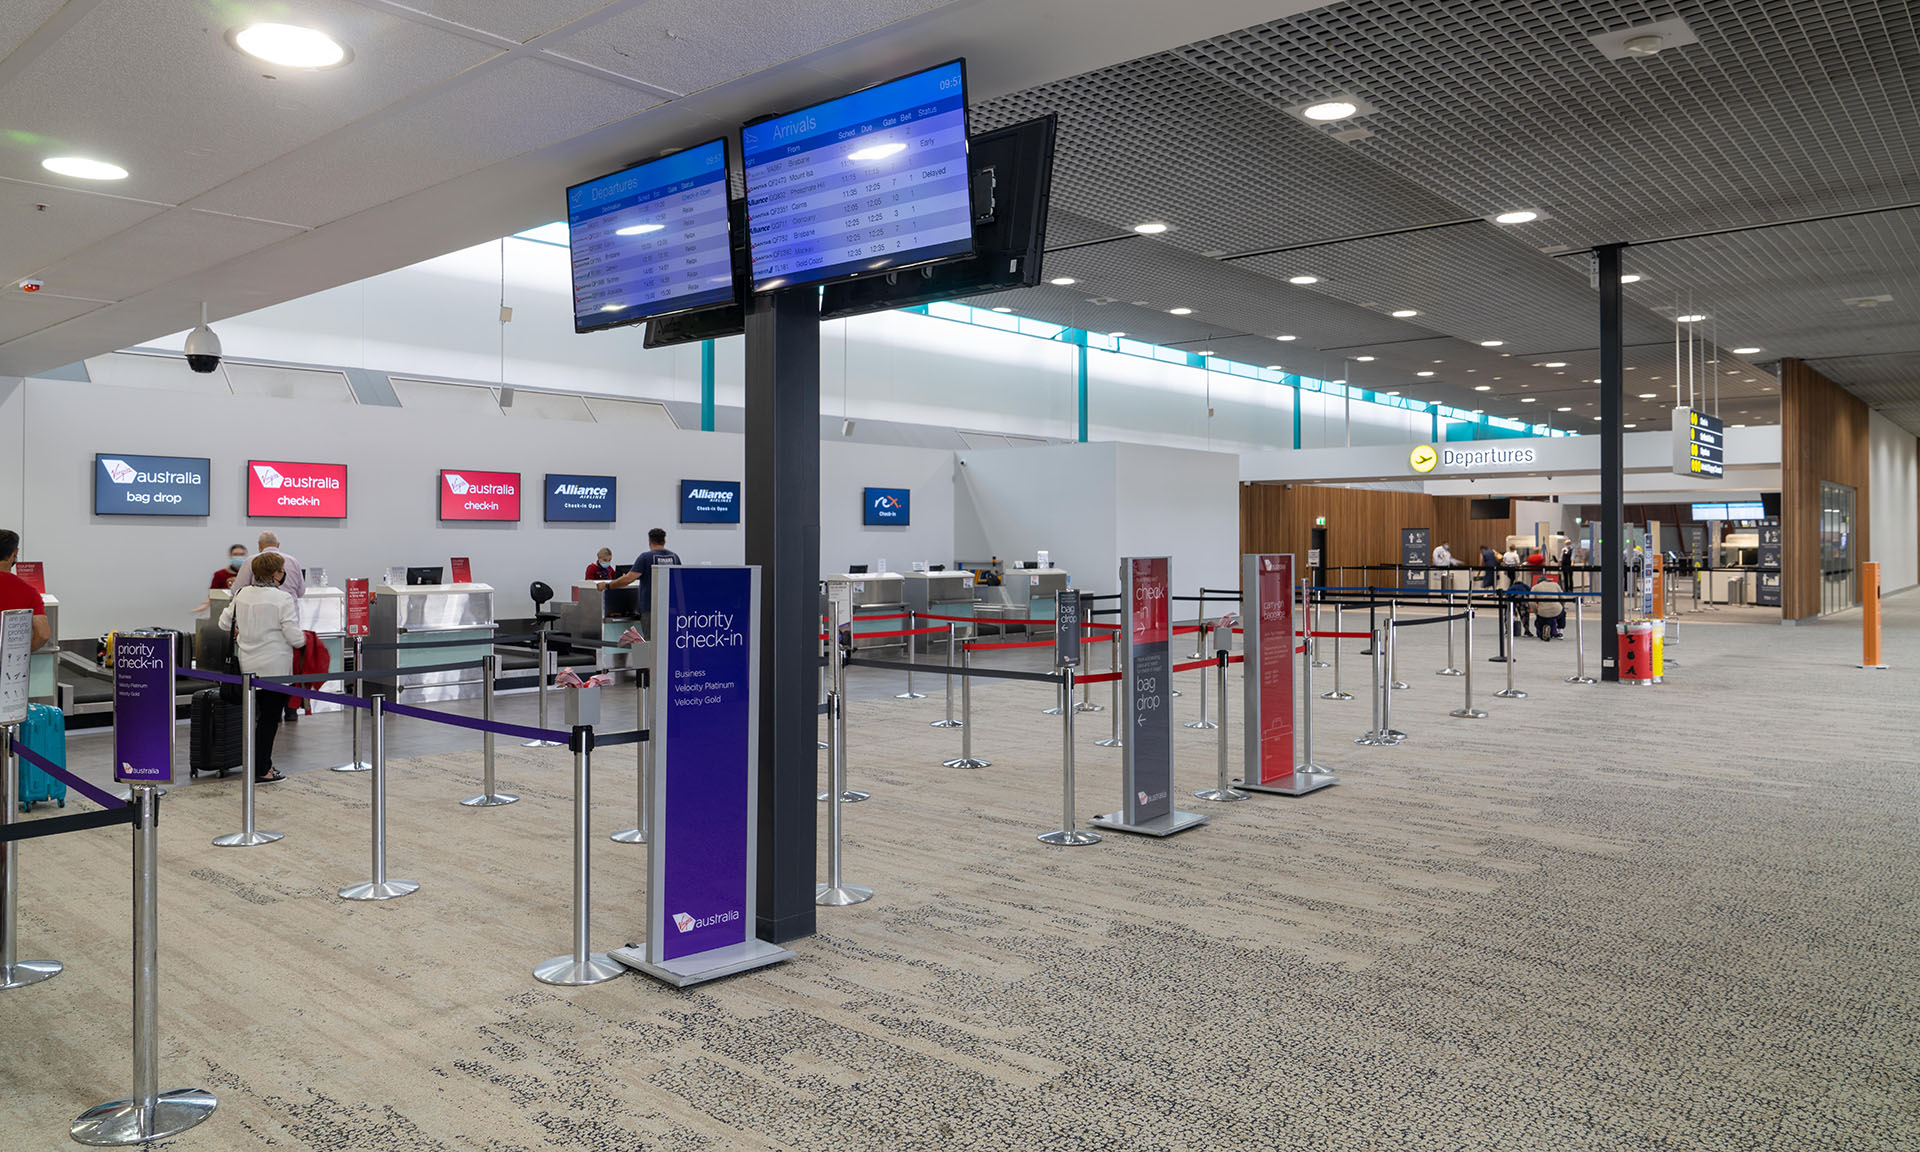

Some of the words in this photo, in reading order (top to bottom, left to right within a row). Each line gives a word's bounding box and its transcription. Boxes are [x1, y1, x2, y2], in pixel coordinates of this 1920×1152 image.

[773, 115, 817, 141] Arrivals
[939, 75, 962, 90] 09:57
[786, 144, 801, 154] From
[838, 128, 856, 140] Sched
[860, 124, 873, 134] Due
[882, 117, 897, 127] Gate
[899, 112, 912, 122] Belt
[917, 106, 938, 117] Status
[919, 138, 936, 148] Early
[865, 182, 881, 193] 12:25
[922, 167, 947, 180] Delayed
[591, 177, 638, 201] Departures
[847, 247, 862, 258] 12:35
[870, 242, 886, 254] 12:35
[1444, 448, 1534, 467] Departures
[137, 471, 201, 485] australia
[283, 476, 340, 489] australia
[469, 483, 515, 495] australia
[554, 484, 608, 496] Alliance
[688, 488, 734, 499] Alliance
[126, 491, 151, 504] bag
[153, 492, 182, 505] drop
[277, 495, 320, 506] check-in
[464, 500, 499, 510] check-in
[1136, 582, 1164, 600] check
[1060, 604, 1075, 615] bag
[1264, 600, 1285, 611] carry-on
[676, 610, 734, 632] priority
[1060, 613, 1077, 625] drop
[1264, 609, 1286, 622] baggage
[675, 629, 743, 649] check-in
[118, 642, 155, 658] priority
[117, 656, 164, 669] check-in
[674, 670, 706, 679] Business
[674, 683, 704, 692] Velocity
[704, 681, 735, 690] Platinum
[1137, 675, 1156, 693] bag
[674, 697, 703, 706] Velocity
[704, 695, 722, 704] Gold
[1136, 693, 1160, 711] drop
[695, 910, 740, 929] australia
